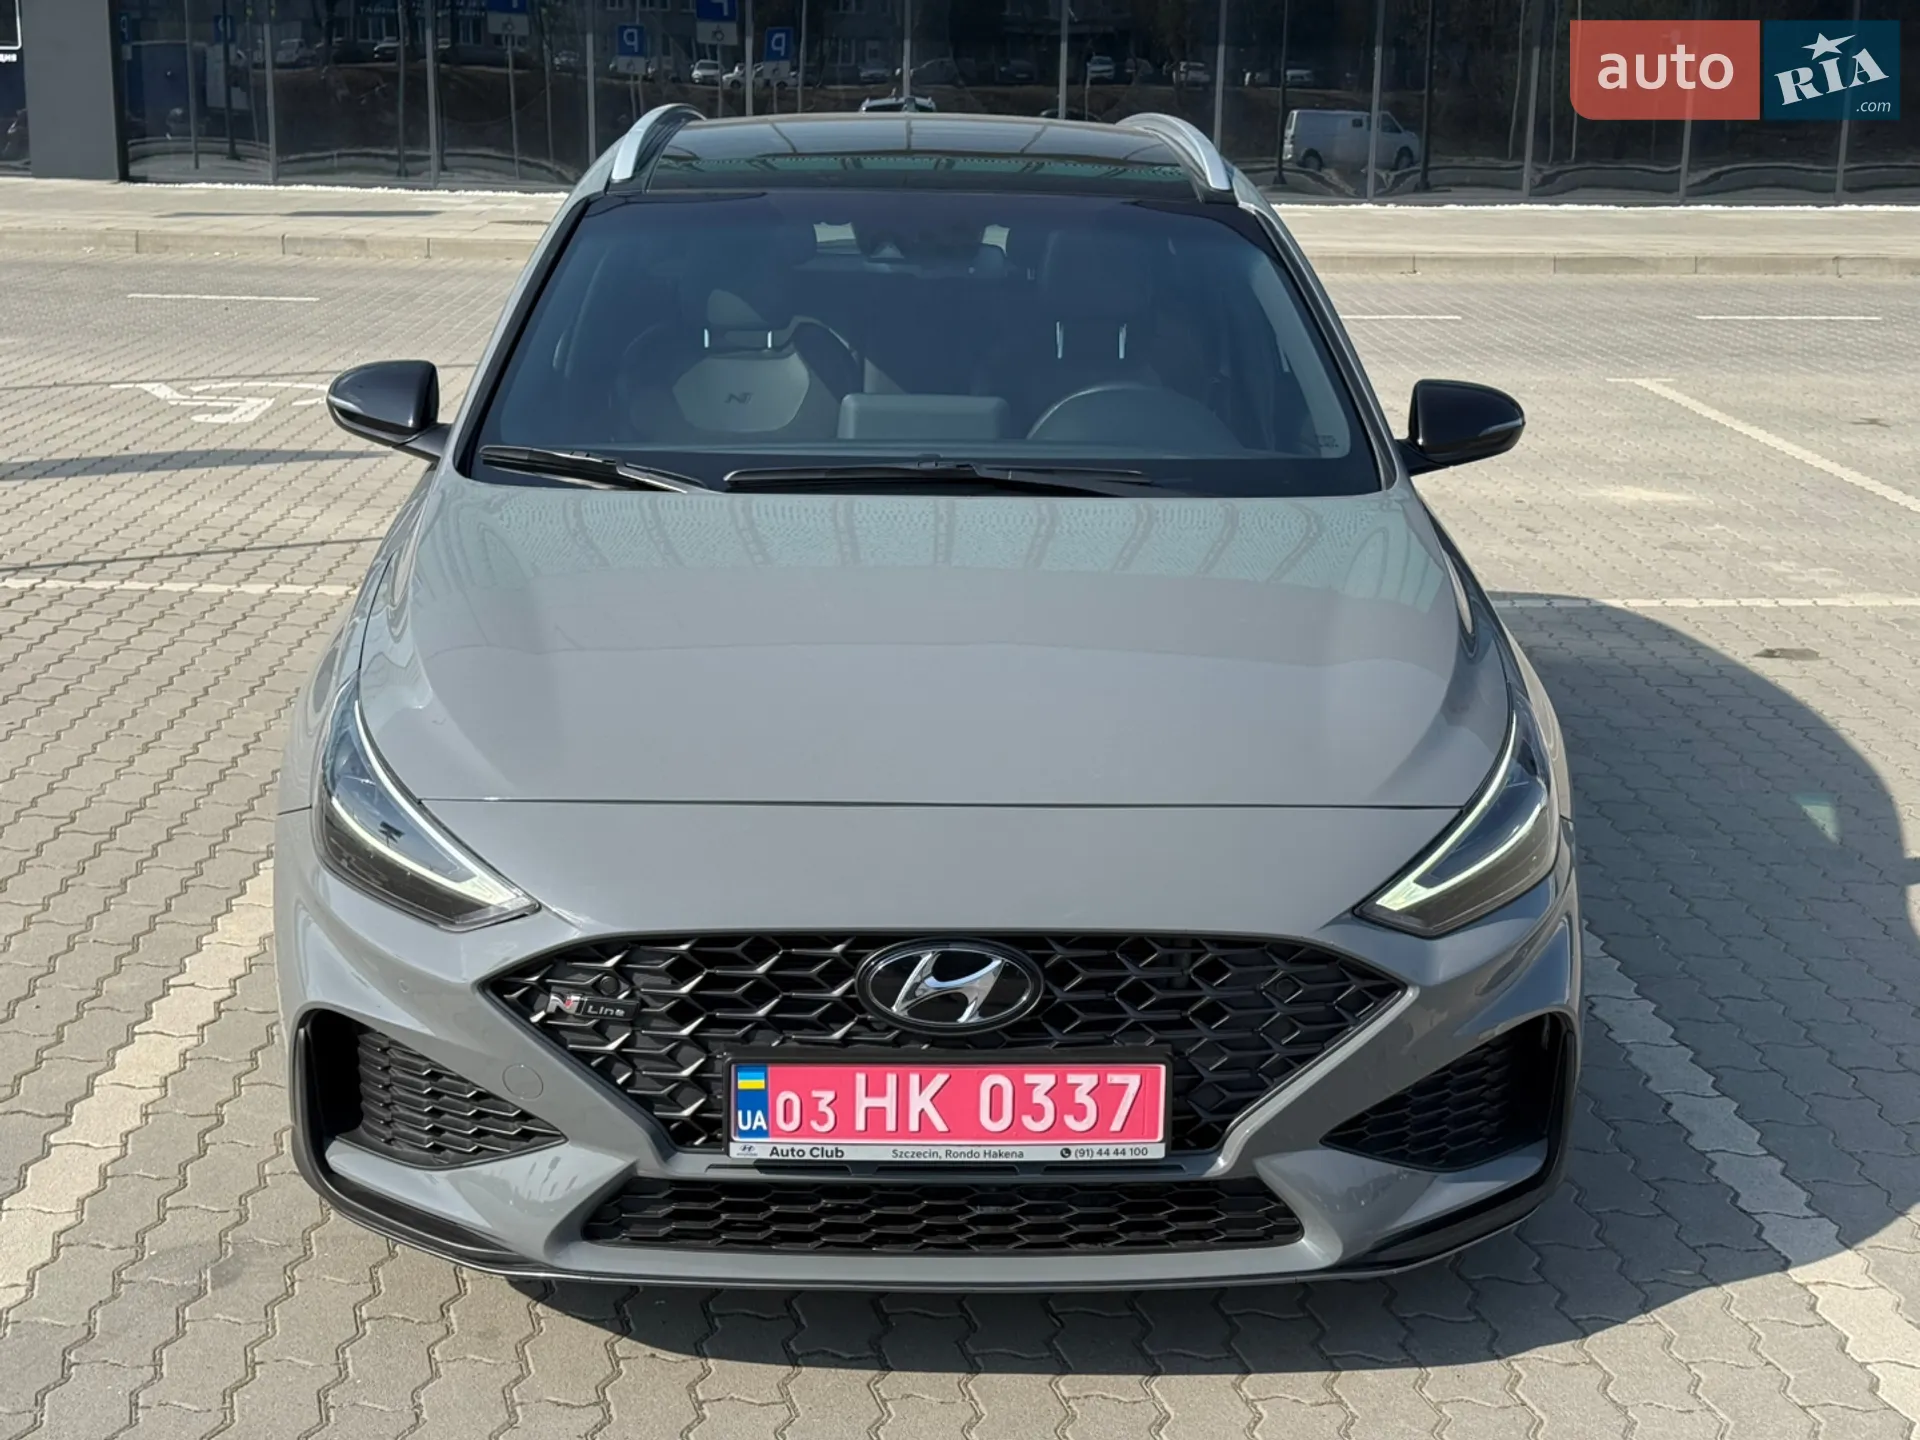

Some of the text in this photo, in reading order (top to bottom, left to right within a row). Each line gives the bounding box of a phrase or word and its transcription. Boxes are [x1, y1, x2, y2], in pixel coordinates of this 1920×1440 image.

[738, 1072, 1143, 1133] UA 03 HK 0337
[769, 1146, 806, 1159] Auto
[809, 1146, 845, 1159] Club
[891, 1149, 943, 1160] Szczecin,
[944, 1149, 981, 1159] Rondo
[983, 1149, 1024, 1159] Hakena
[1074, 1147, 1094, 1159] (91)
[1096, 1148, 1110, 1157] 44
[1112, 1148, 1126, 1157] 44
[1129, 1147, 1148, 1157] 100
